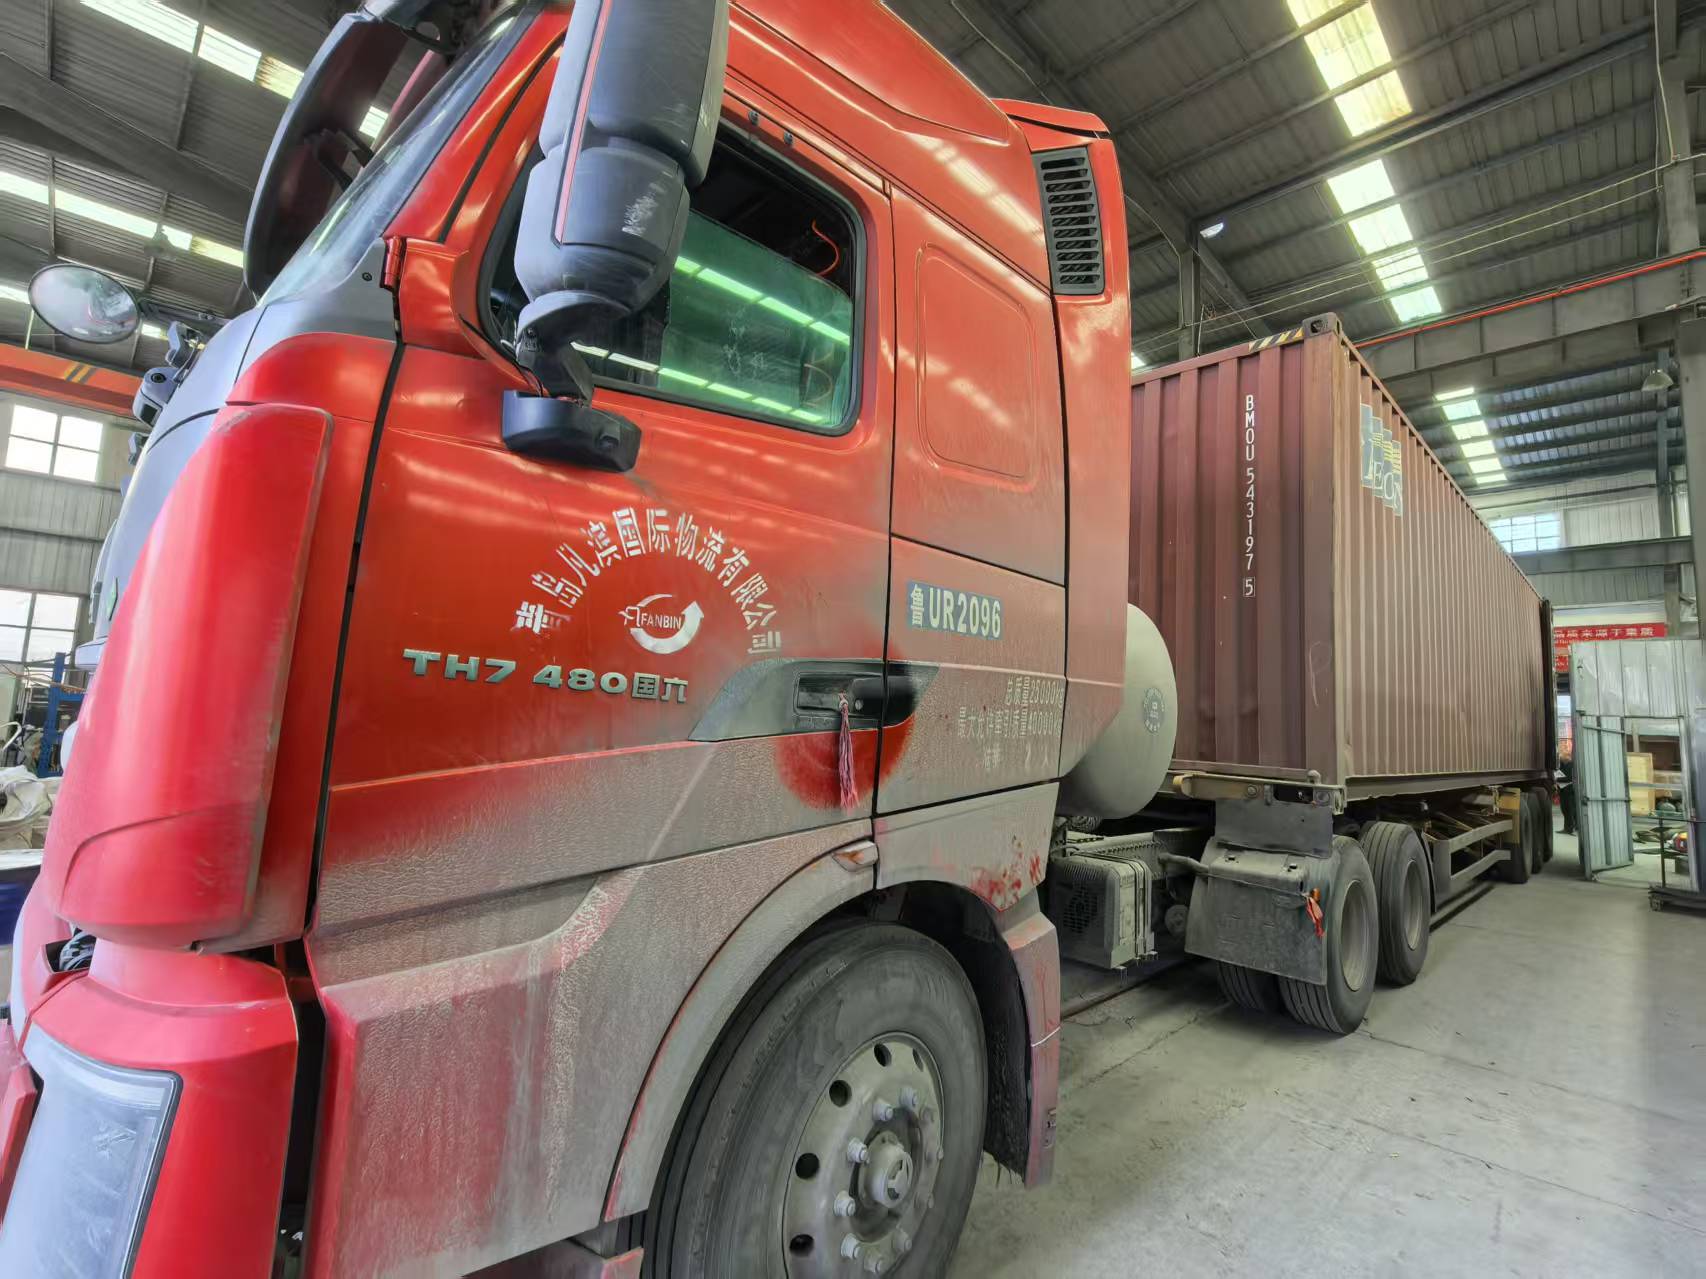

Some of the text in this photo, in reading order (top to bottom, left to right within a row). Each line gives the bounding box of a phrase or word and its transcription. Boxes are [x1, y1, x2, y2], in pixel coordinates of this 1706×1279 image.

[1245, 394, 1255, 461] BMOU
[1245, 467, 1255, 571] 543197
[641, 612, 682, 630] FANBIN
[910, 583, 1001, 638] 鲁UR2096
[402, 647, 689, 704] TH7 480国六
